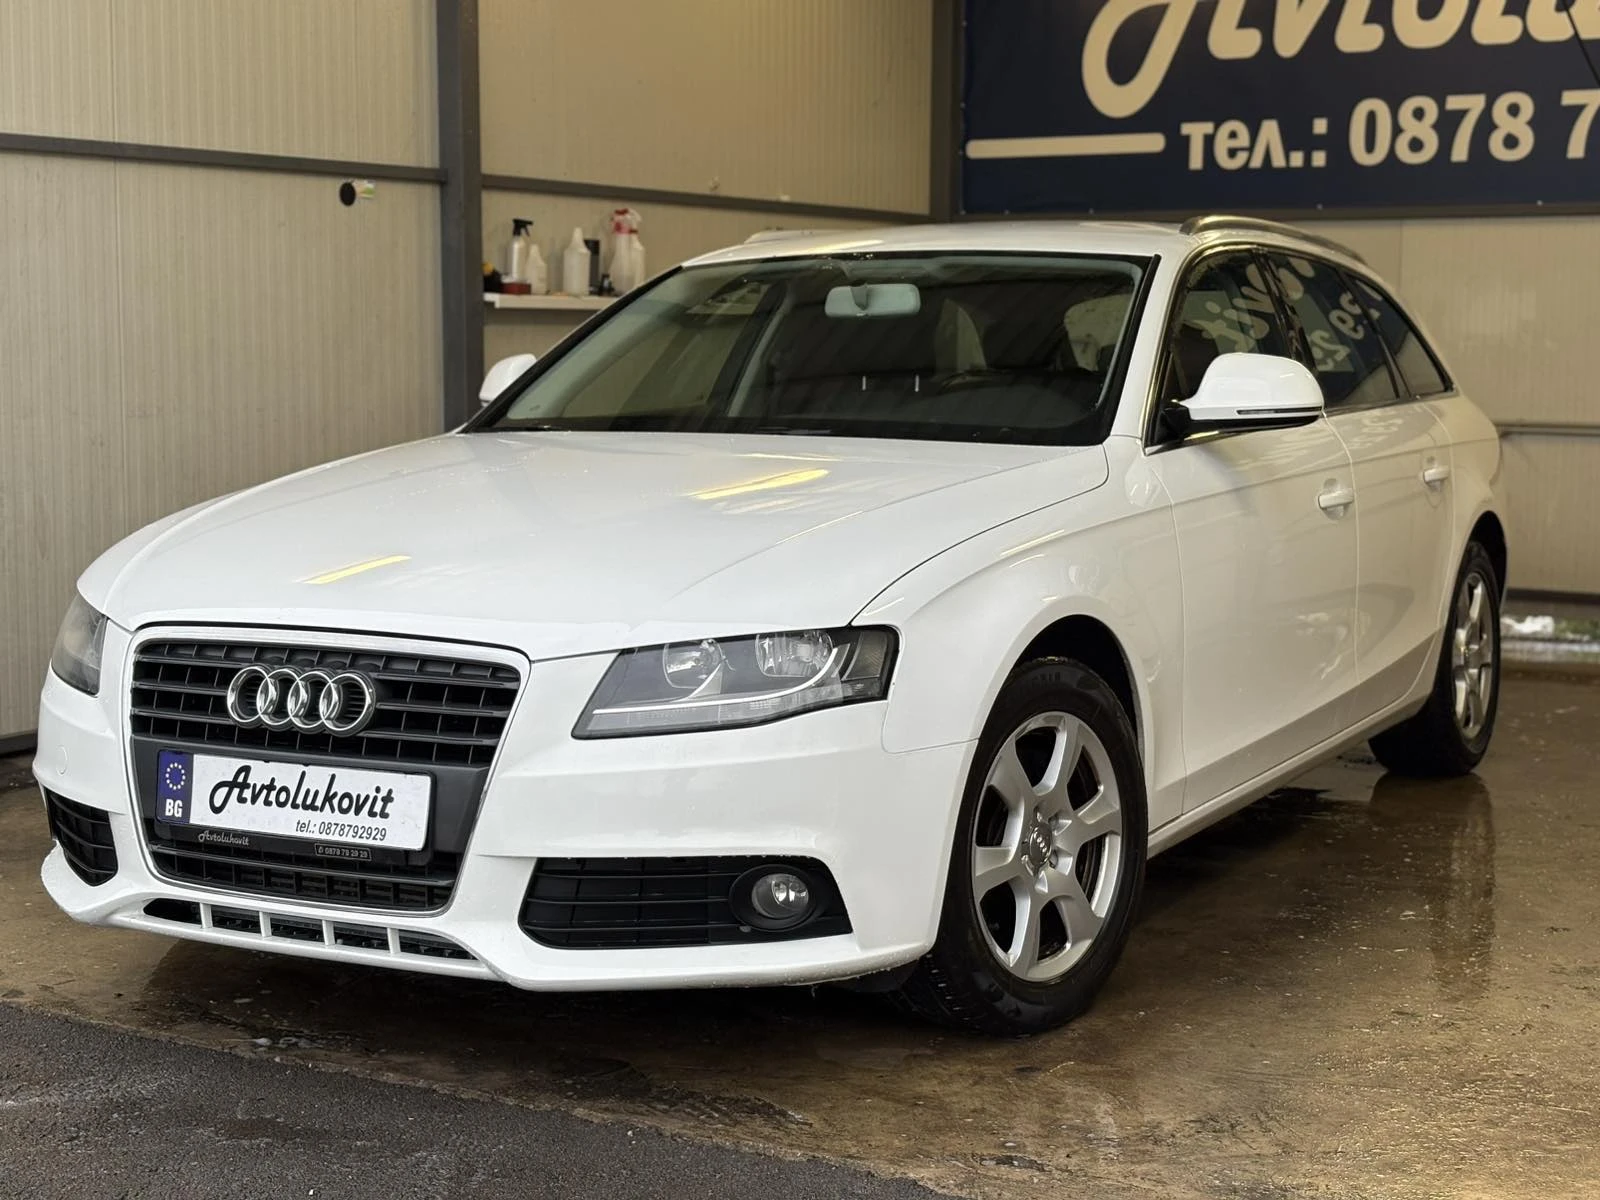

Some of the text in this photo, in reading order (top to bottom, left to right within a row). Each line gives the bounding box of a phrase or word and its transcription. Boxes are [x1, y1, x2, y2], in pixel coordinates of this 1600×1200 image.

[1349, 91, 1535, 167] 0878
[165, 798, 183, 818] BG
[209, 765, 395, 819] Avtolukovit
[296, 819, 387, 842] tel.: 0878792929
